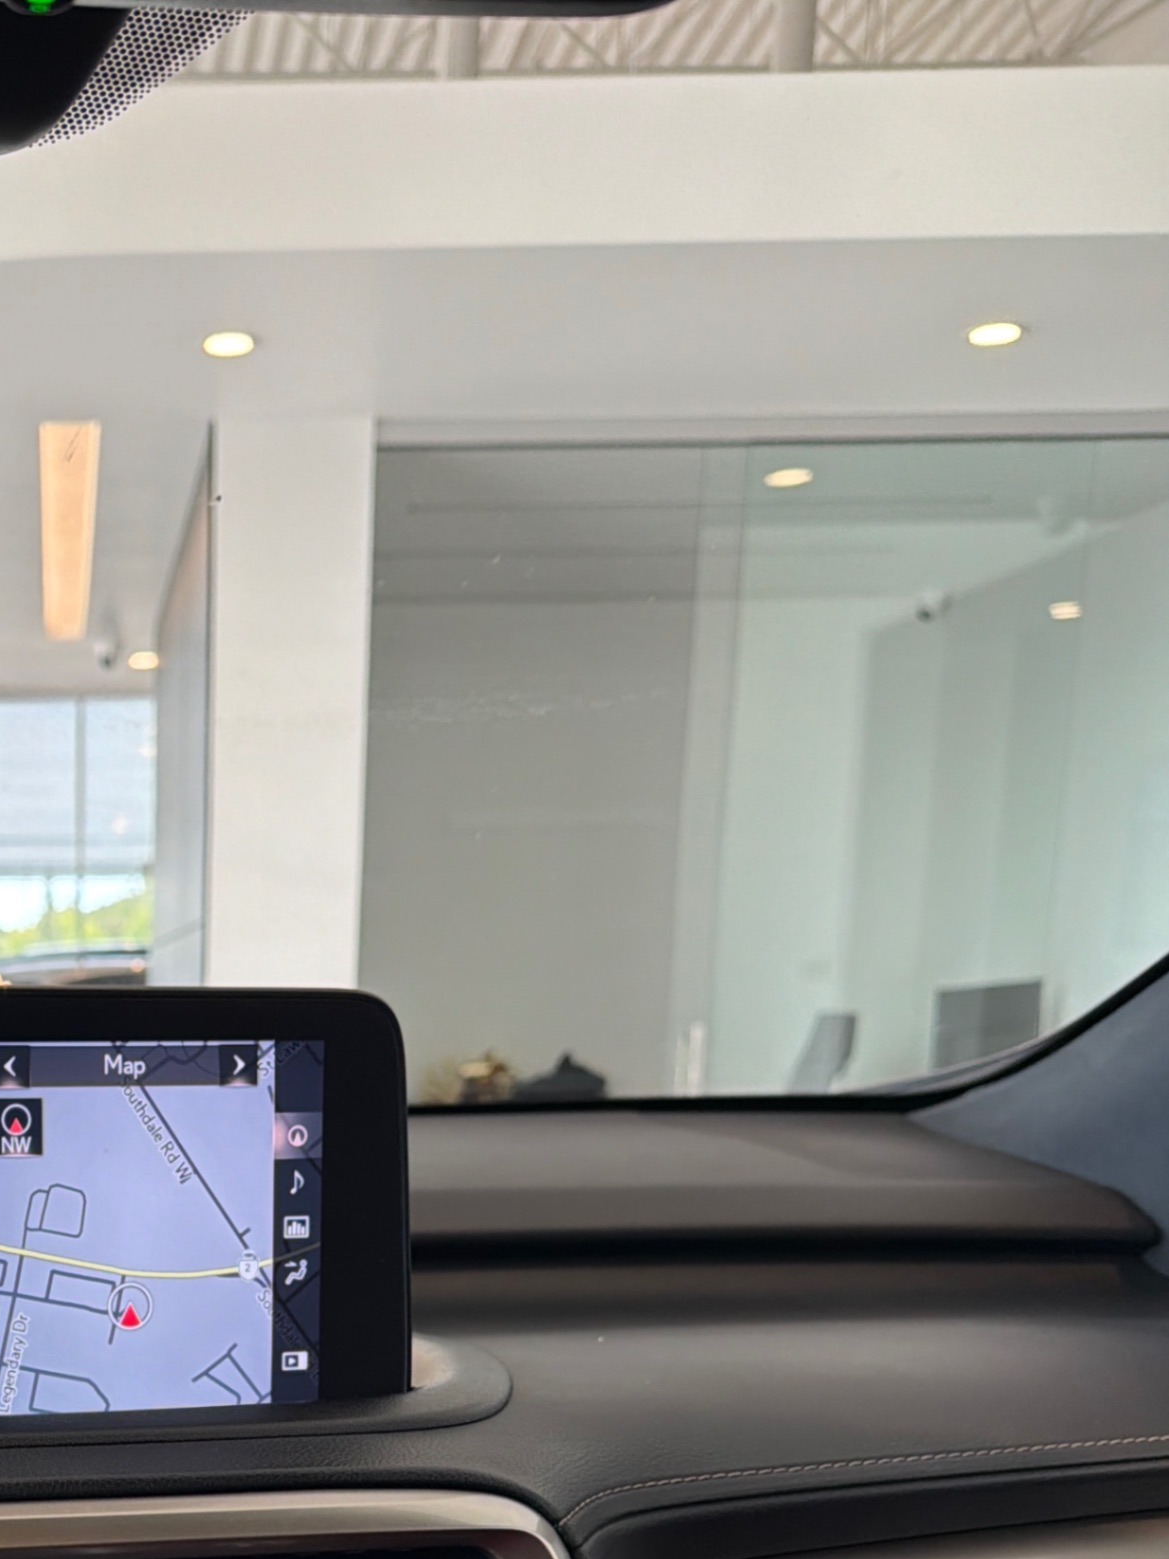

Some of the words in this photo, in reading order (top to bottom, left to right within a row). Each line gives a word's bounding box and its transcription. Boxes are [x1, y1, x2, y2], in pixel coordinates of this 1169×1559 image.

[104, 1053, 146, 1079] Map
[1, 1136, 32, 1154] NW
[160, 1141, 179, 1164] Rd
[13, 1315, 30, 1333] Dr
